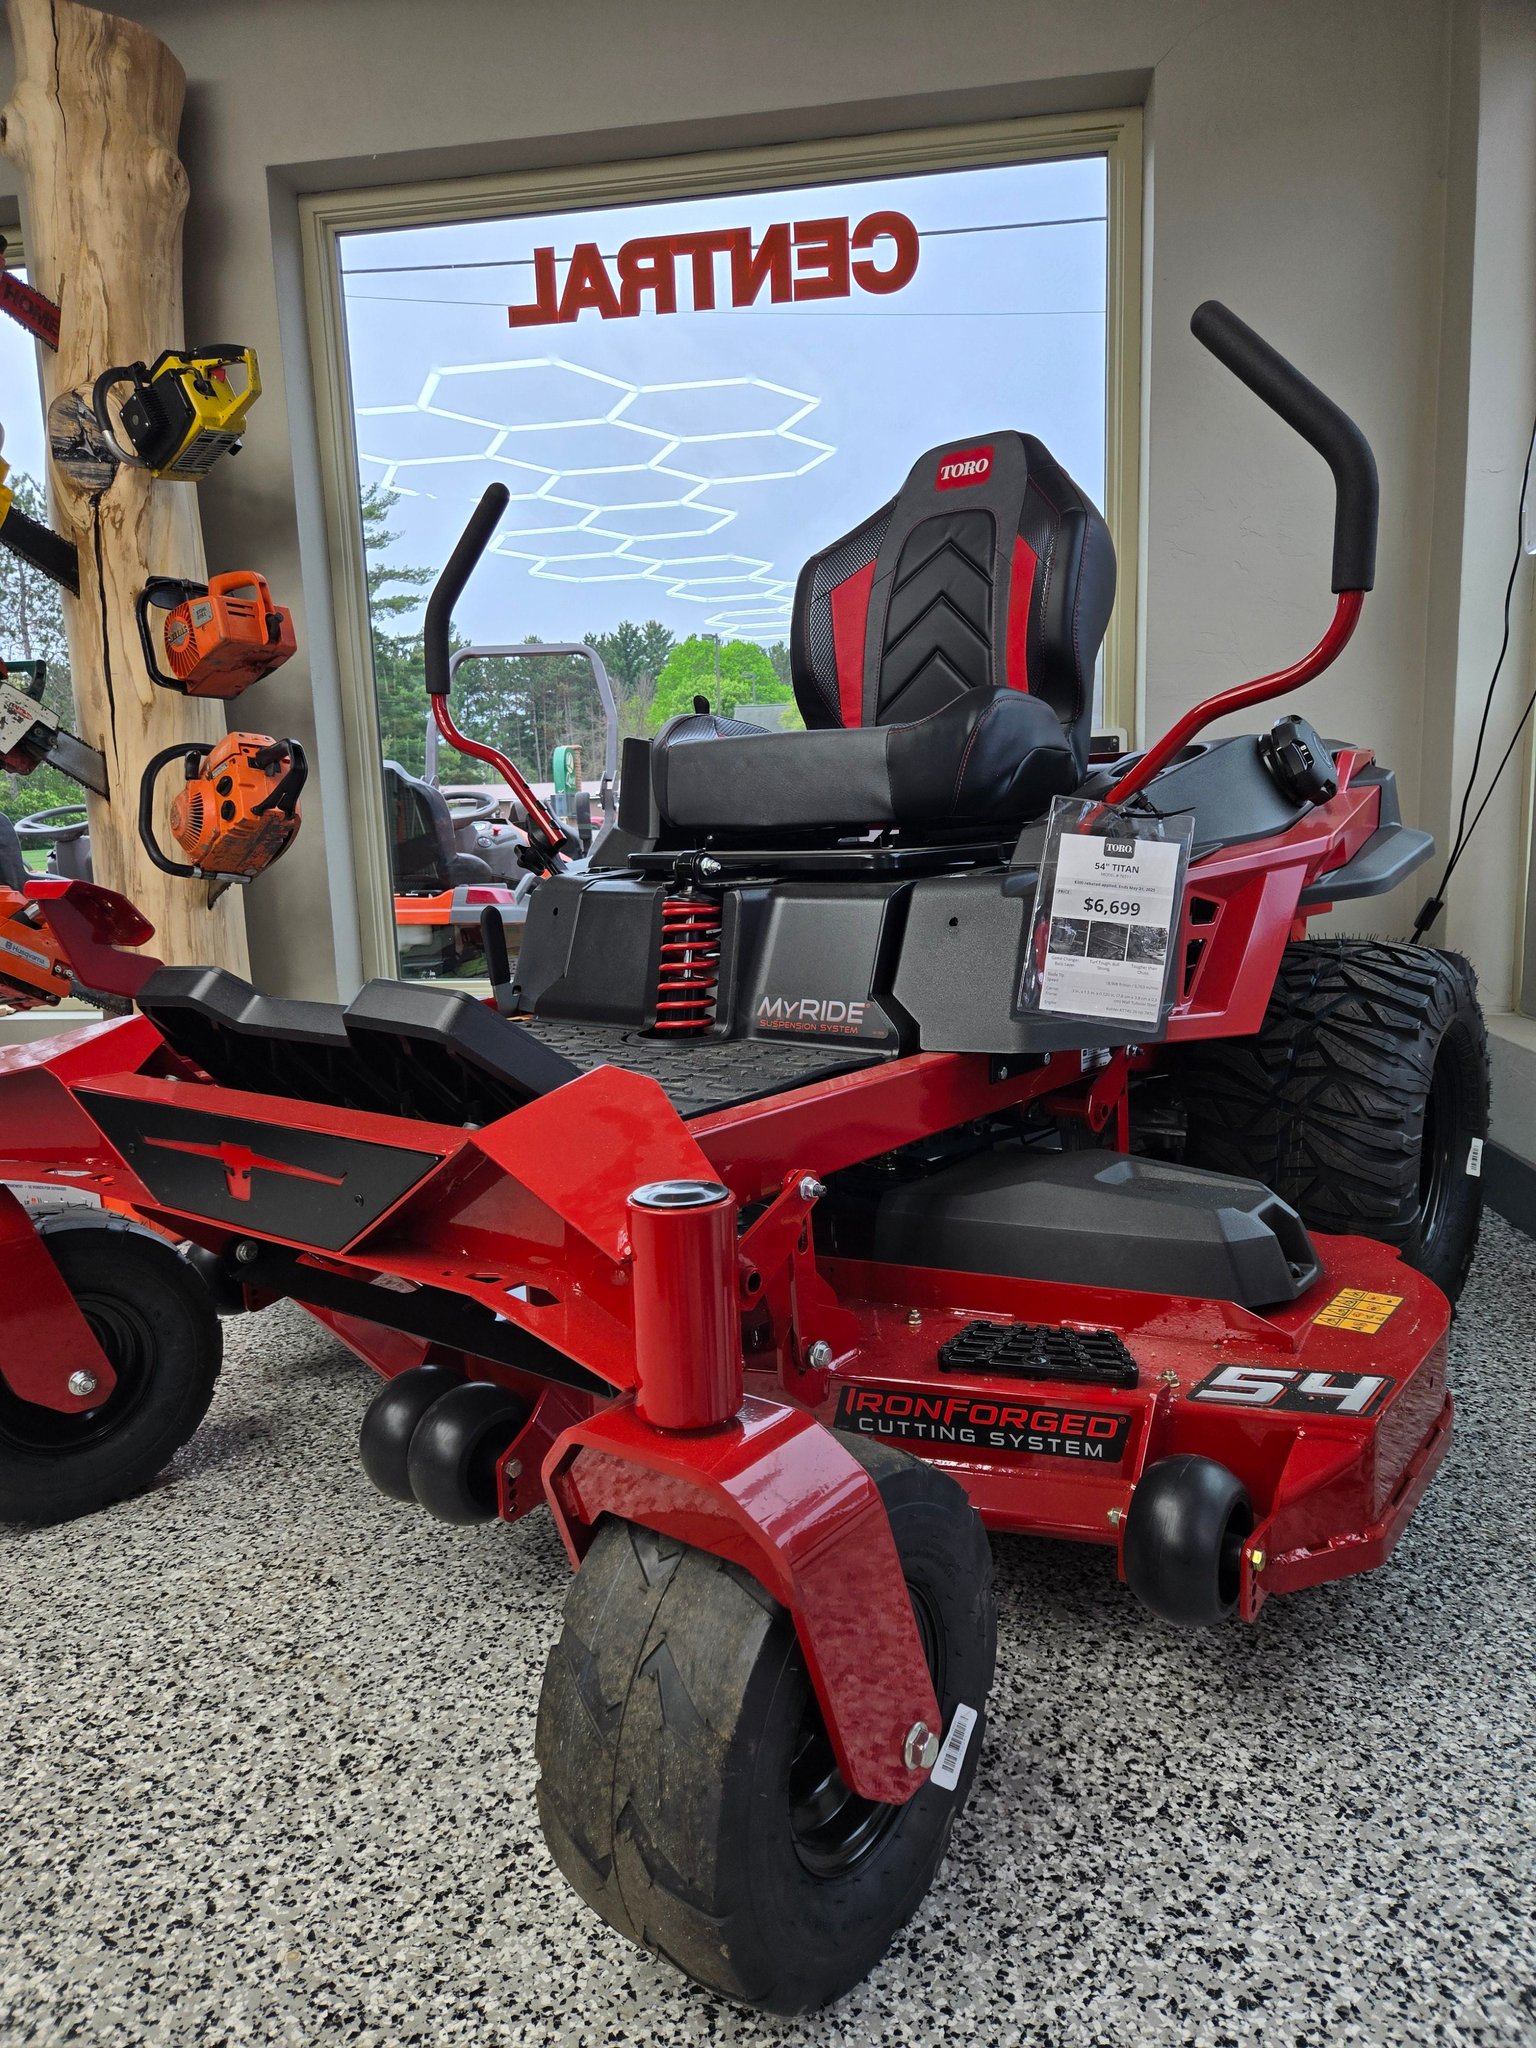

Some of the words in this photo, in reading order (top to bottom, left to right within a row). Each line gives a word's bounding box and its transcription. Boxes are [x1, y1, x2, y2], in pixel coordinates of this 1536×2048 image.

[940, 458, 989, 480] TORO
[1106, 843, 1132, 853] TORO
[1094, 862, 1110, 871] 54"
[1112, 863, 1140, 874] TITAN
[1083, 897, 1141, 916] $6,699
[12, 944, 46, 965] Husqvarna
[759, 1019, 817, 1031] SUSPENSION
[819, 1023, 859, 1035] SYSTEM
[1194, 1366, 1389, 1415] 54
[857, 1417, 976, 1444] CUTTING
[989, 1431, 1104, 1459] SYSTEM
